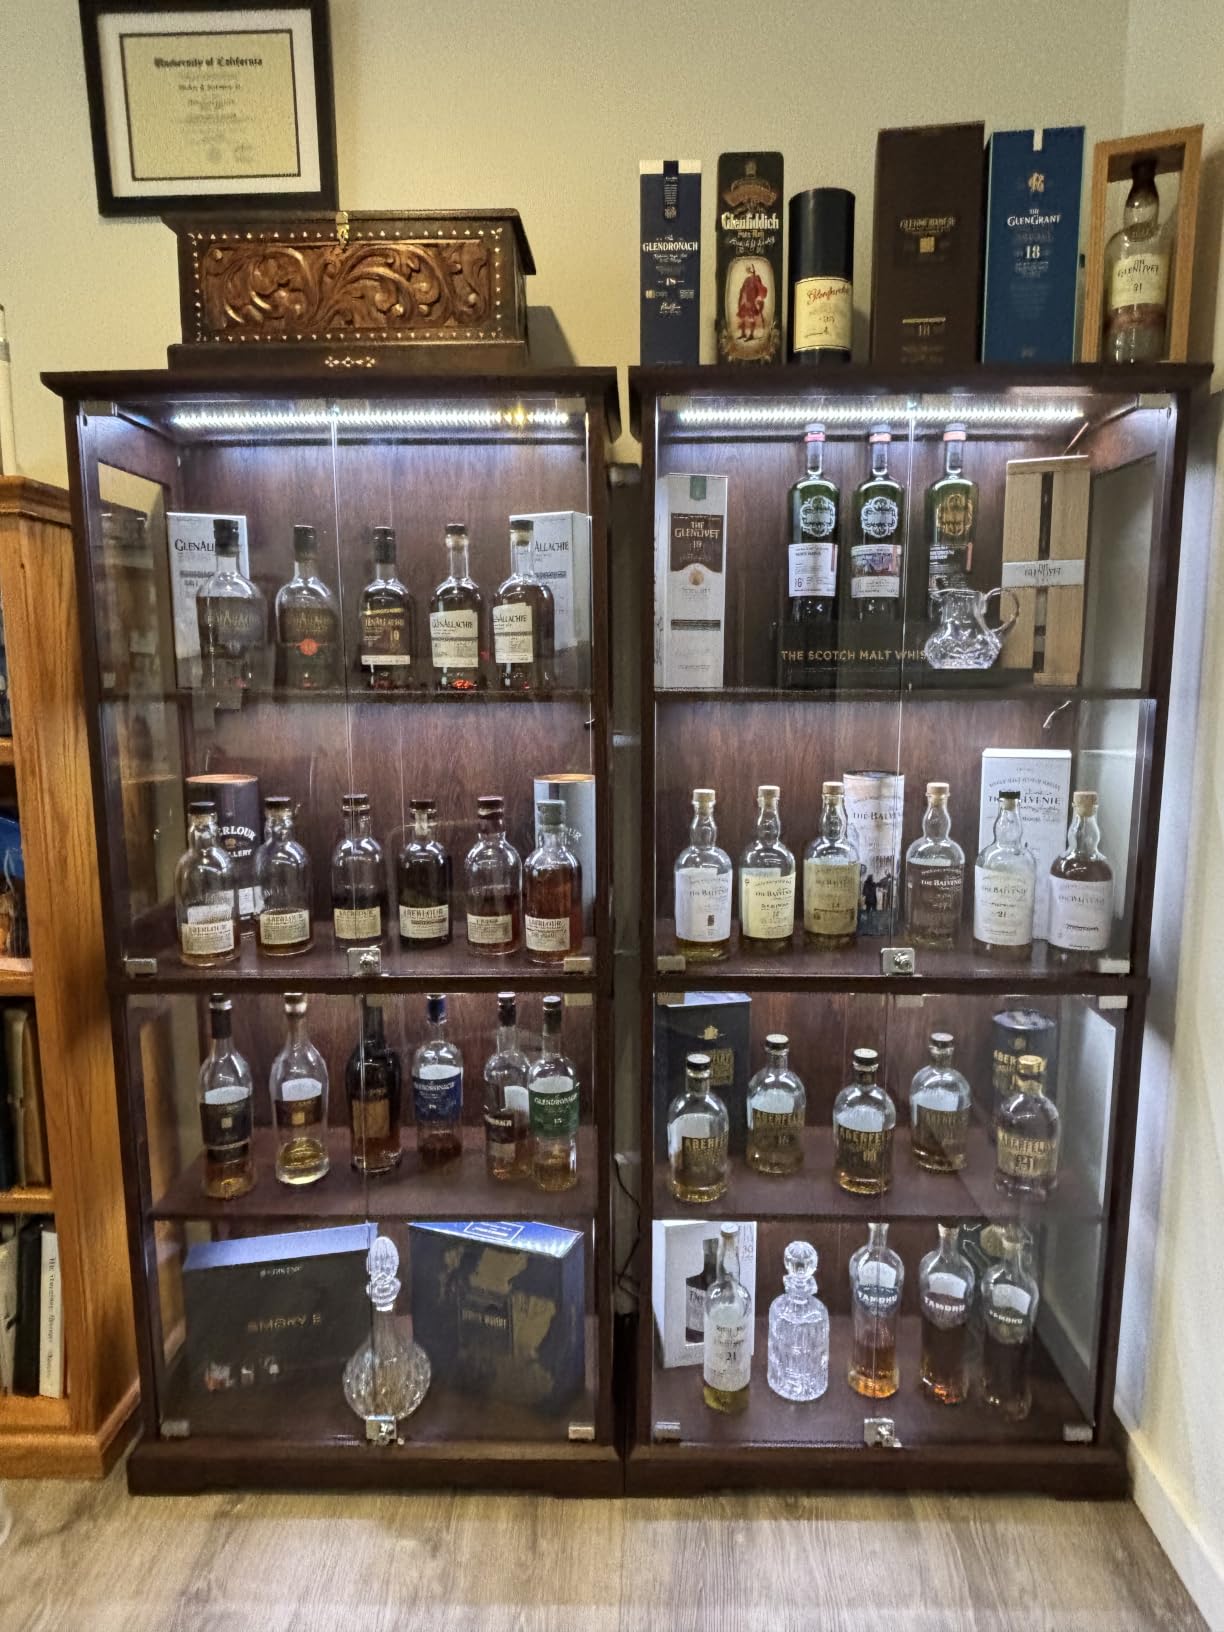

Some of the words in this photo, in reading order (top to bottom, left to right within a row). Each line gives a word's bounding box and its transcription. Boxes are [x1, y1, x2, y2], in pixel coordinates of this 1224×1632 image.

[153, 57, 203, 69] University
[205, 57, 213, 67] of
[217, 56, 263, 67] California
[721, 211, 779, 230] Glenfiddich
[642, 241, 699, 252] GLENDRONACH
[1026, 245, 1041, 259] 18
[674, 528, 721, 539] GLENLIVET
[781, 651, 804, 661] THE
[808, 651, 855, 661] SCOTCH
[860, 650, 892, 660] MALT
